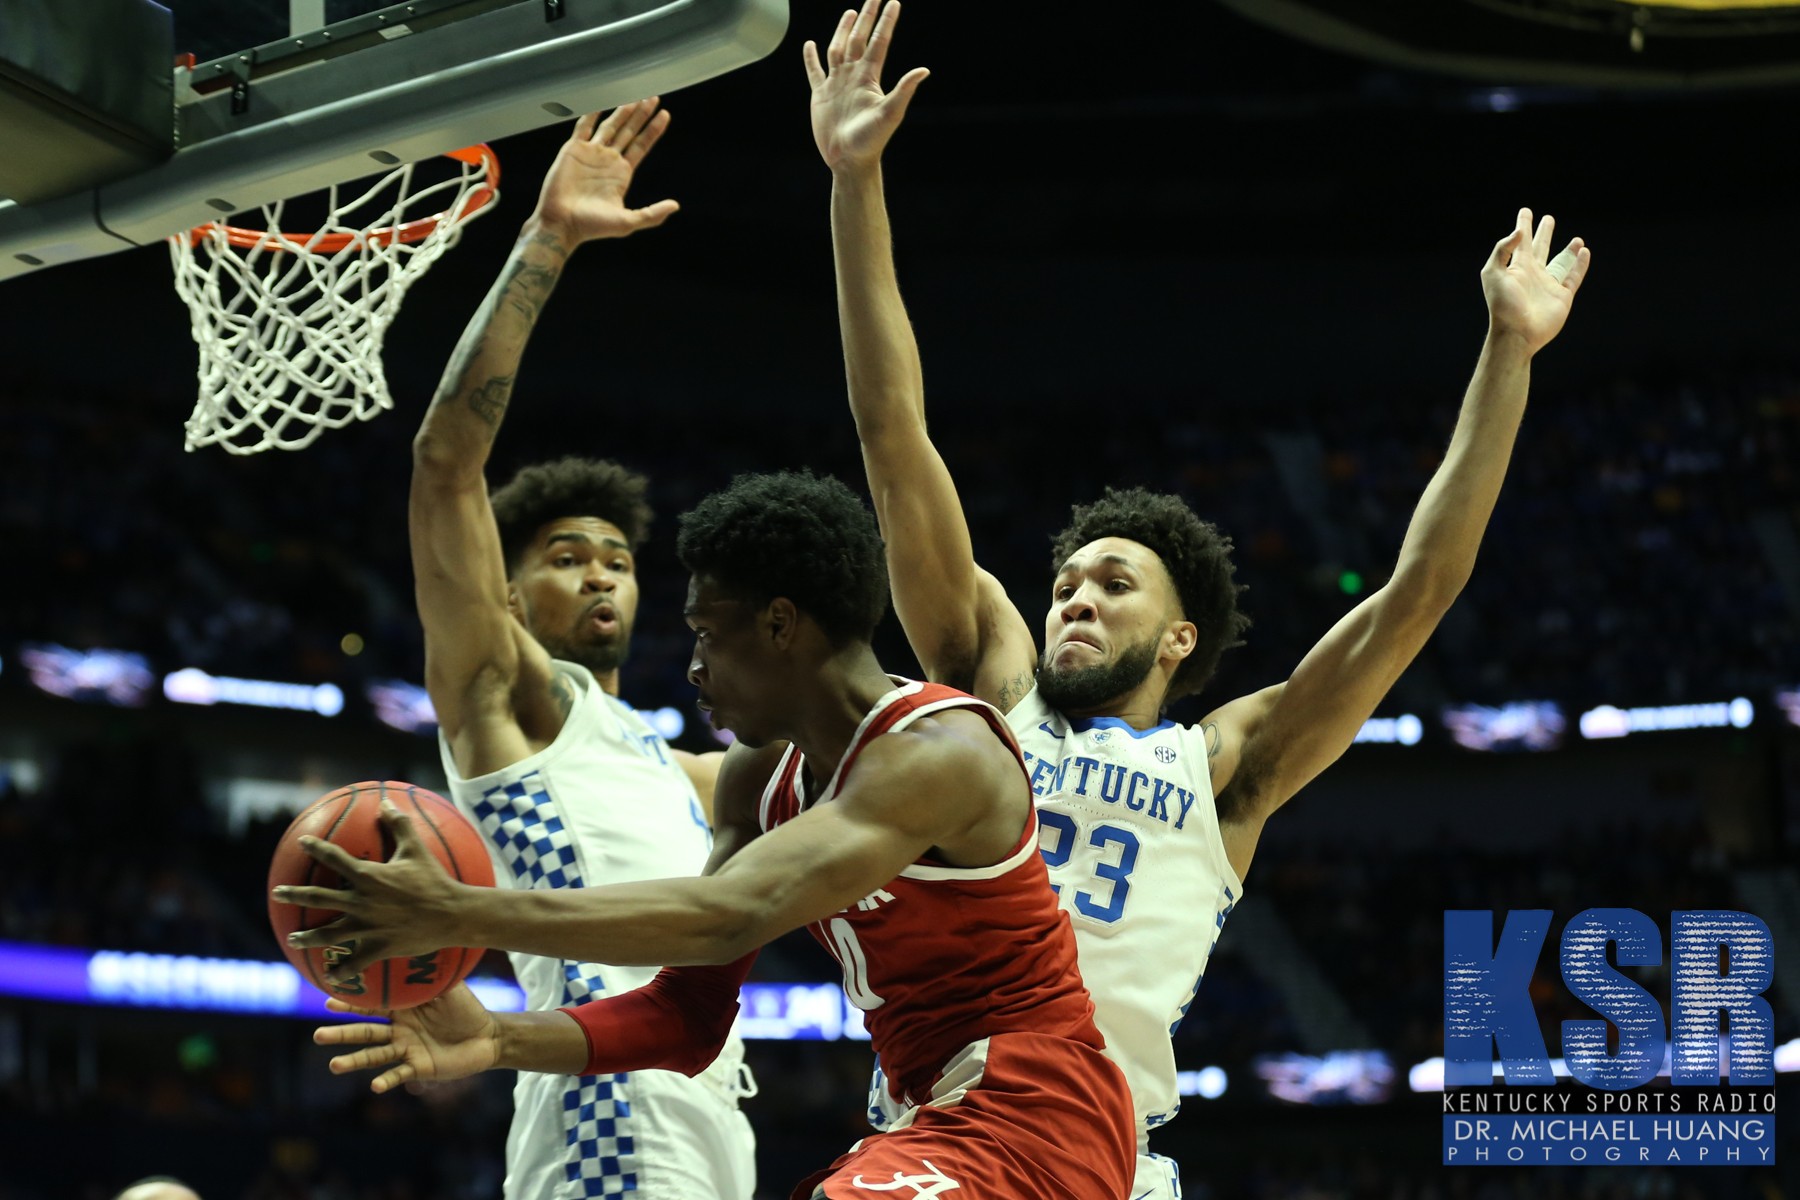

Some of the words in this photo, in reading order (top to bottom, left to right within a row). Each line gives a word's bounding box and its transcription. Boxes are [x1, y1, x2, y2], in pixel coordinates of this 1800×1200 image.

[1022, 751, 1195, 830] ENTUCKY
[1155, 746, 1176, 764] SEC
[1037, 808, 1141, 924] 23
